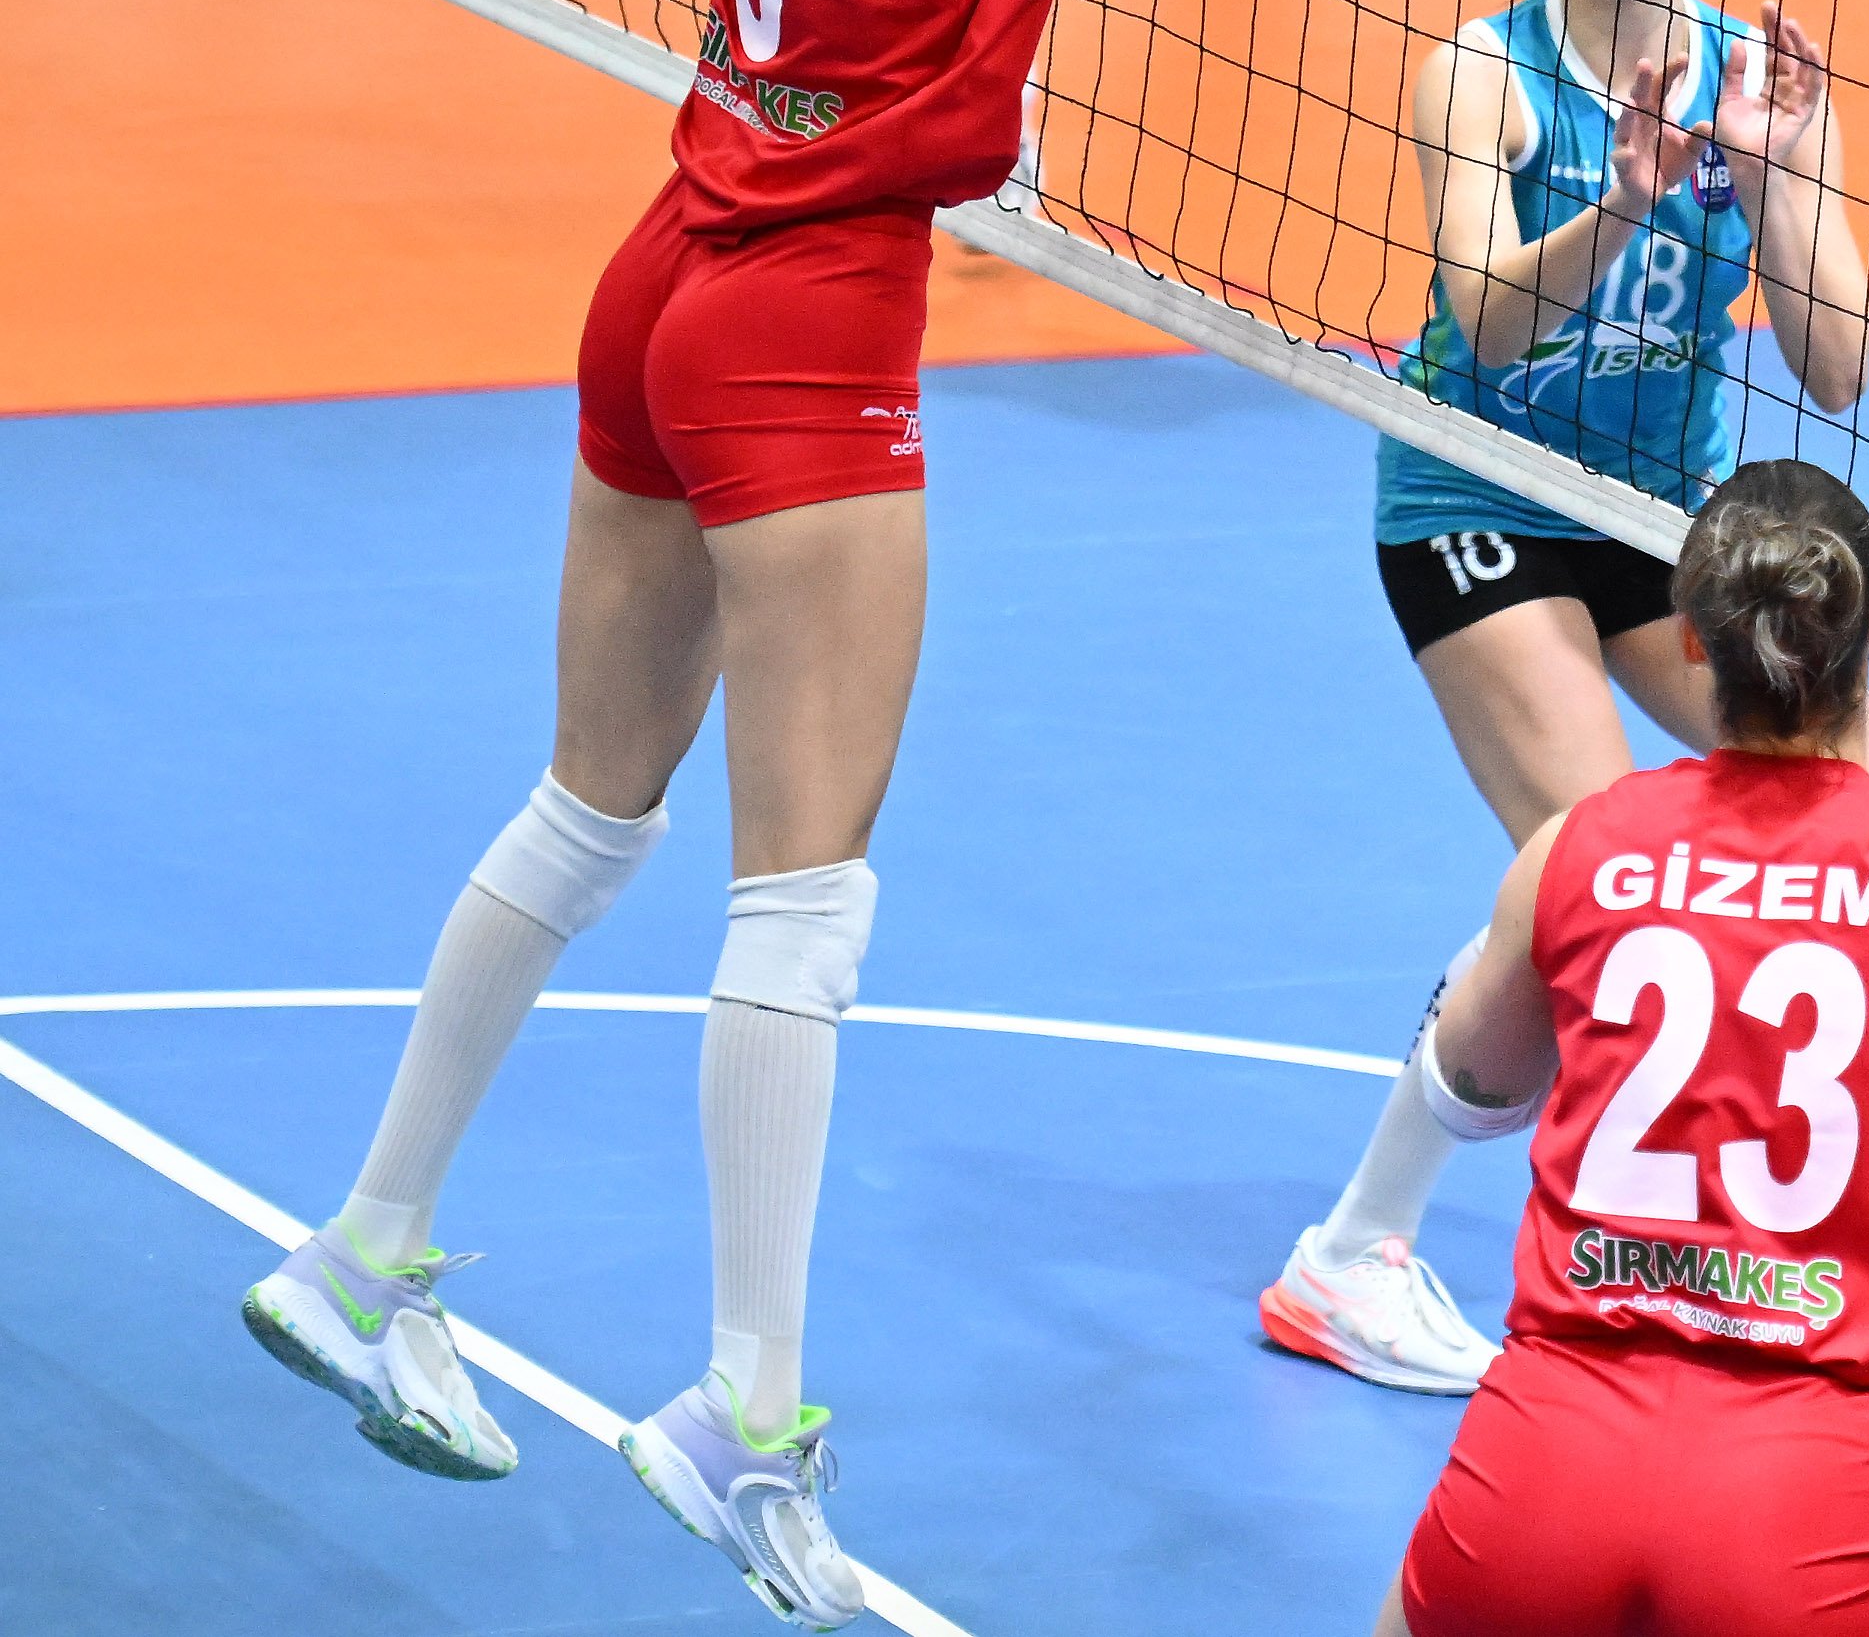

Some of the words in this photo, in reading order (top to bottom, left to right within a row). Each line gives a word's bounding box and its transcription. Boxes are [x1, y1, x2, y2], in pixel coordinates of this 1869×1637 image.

[1600, 231, 1689, 325] 18
[1567, 925, 1868, 1235] 23
[1566, 1228, 1845, 1331] SIRMAKEŞ
[1673, 1302, 1748, 1339] KAYNAK
[1750, 1321, 1805, 1346] SUYU
